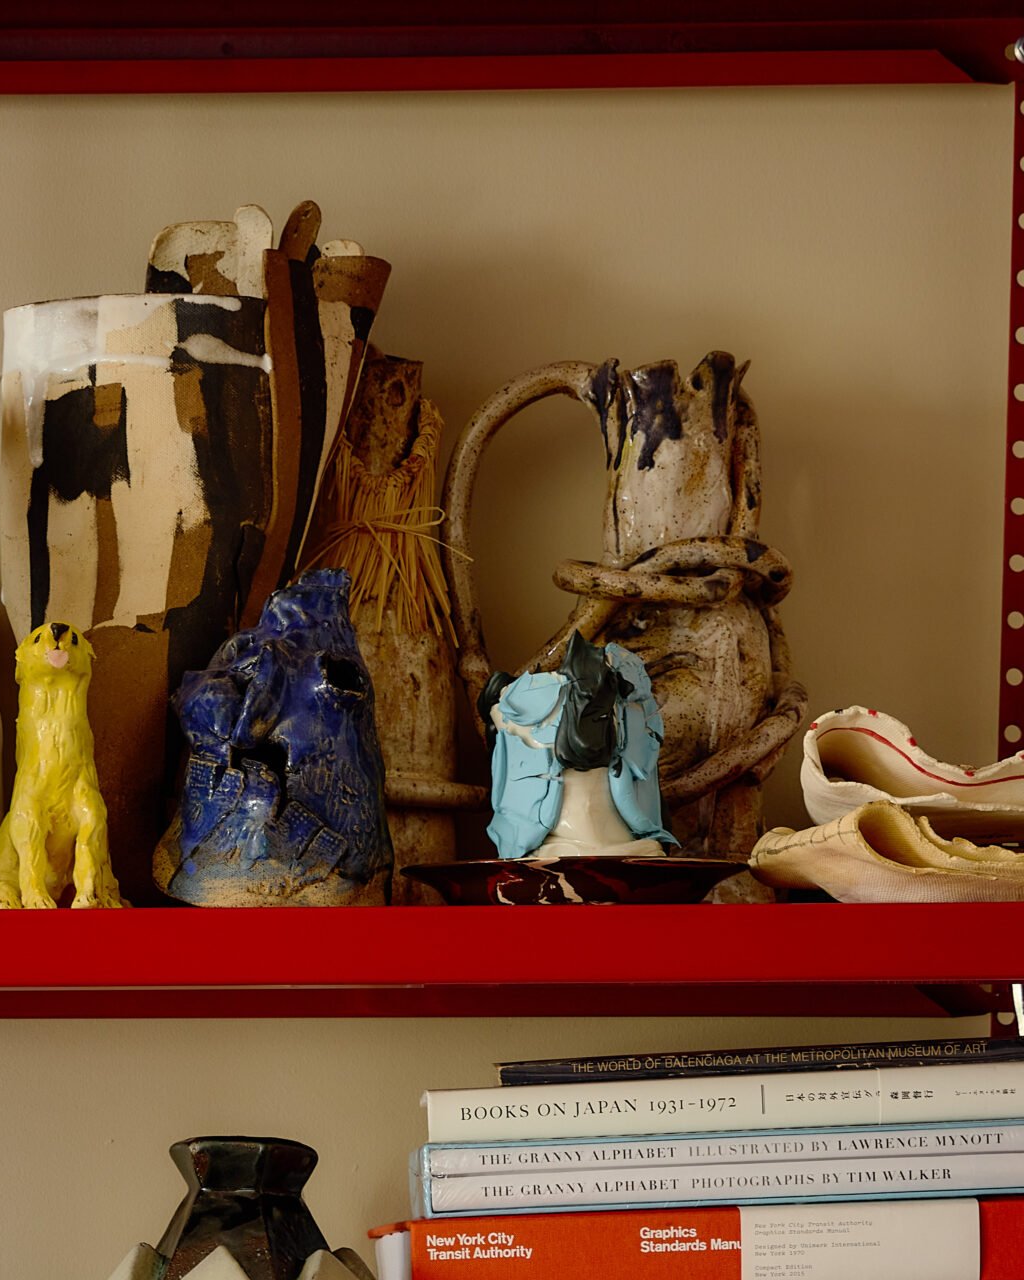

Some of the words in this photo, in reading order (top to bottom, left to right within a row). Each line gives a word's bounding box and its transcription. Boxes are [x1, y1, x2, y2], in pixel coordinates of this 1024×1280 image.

[570, 1061, 595, 1074] THE
[596, 1057, 642, 1073] WORLD
[644, 1056, 662, 1070] OF
[664, 1054, 742, 1069] BALENCIAGA
[744, 1053, 760, 1066] AT
[763, 1051, 788, 1064] THE
[790, 1048, 887, 1063] METROPOLITAN
[888, 1046, 941, 1058] MUSEUM
[943, 1043, 961, 1056] OF
[963, 1041, 988, 1055] ART
[461, 1104, 529, 1121] BOOKS
[537, 1102, 566, 1117] ON
[572, 1097, 638, 1118] JAPAN
[650, 1097, 737, 1114] 1931-1972
[478, 1152, 513, 1166] THE
[518, 1151, 581, 1164] GRANNY
[590, 1147, 678, 1162] ALPHABET
[687, 1142, 805, 1158] ILLUSTRATED
[811, 1140, 828, 1152] BY
[837, 1136, 929, 1152] LAWRENCE
[934, 1131, 1005, 1148] MYNOTT
[481, 1185, 515, 1198] THE
[520, 1182, 584, 1195] GRANNY
[594, 1178, 680, 1194] ALPHABET
[691, 1174, 815, 1189] PHOTOGRAPHS
[822, 1172, 839, 1184] BY
[845, 1169, 878, 1184] TIM
[882, 1168, 951, 1181] WALKER
[769, 1221, 787, 1230] York
[787, 1220, 805, 1231] City
[807, 1219, 835, 1229] Transit
[837, 1218, 874, 1229] Authority
[787, 1227, 825, 1237] Standards
[826, 1226, 851, 1236] Manual
[426, 1234, 456, 1247] New
[456, 1233, 486, 1246] York
[487, 1232, 515, 1250] City
[639, 1226, 698, 1242] Graphics
[426, 1247, 471, 1261] Transit
[472, 1243, 533, 1260] Authority
[640, 1236, 707, 1253] Standards
[753, 1241, 787, 1252] Designed
[788, 1240, 799, 1251] by
[830, 1239, 882, 1249] International
[754, 1250, 768, 1258] New
[769, 1249, 787, 1258] York
[754, 1264, 784, 1274] Compact
[784, 1262, 814, 1272] Edition
[754, 1271, 768, 1279] New
[769, 1270, 787, 1279] York
